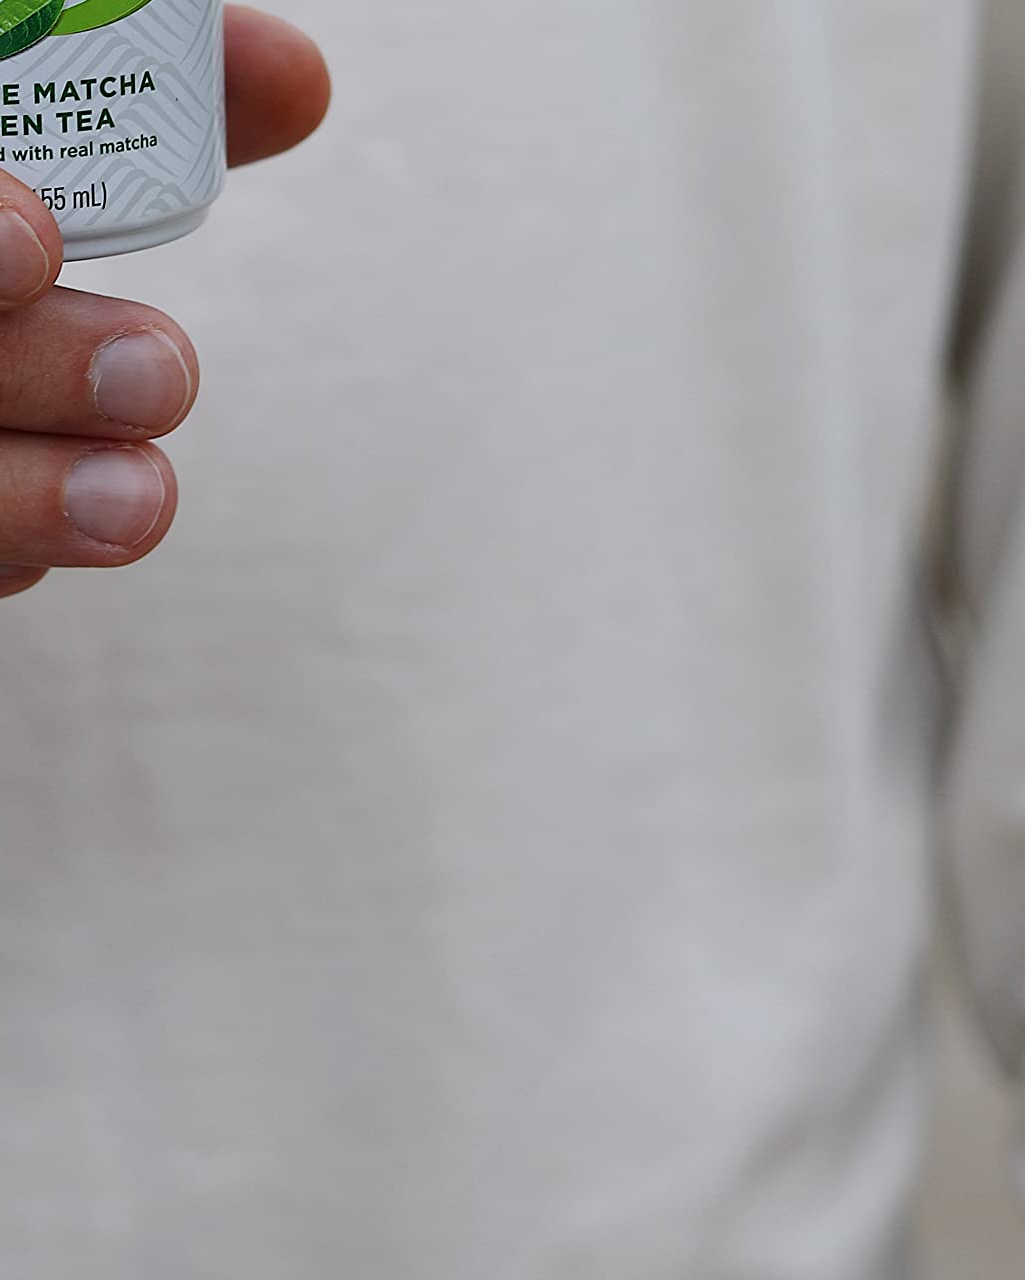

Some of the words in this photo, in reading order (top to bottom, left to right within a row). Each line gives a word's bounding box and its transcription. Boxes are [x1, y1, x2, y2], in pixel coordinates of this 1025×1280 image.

[33, 70, 156, 104] MATCHA
[55, 107, 116, 133] TEA
[11, 145, 54, 162] with
[59, 141, 94, 159] real
[99, 133, 158, 155] matcha
[32, 185, 66, 211] 55
[73, 180, 108, 211] mL)
